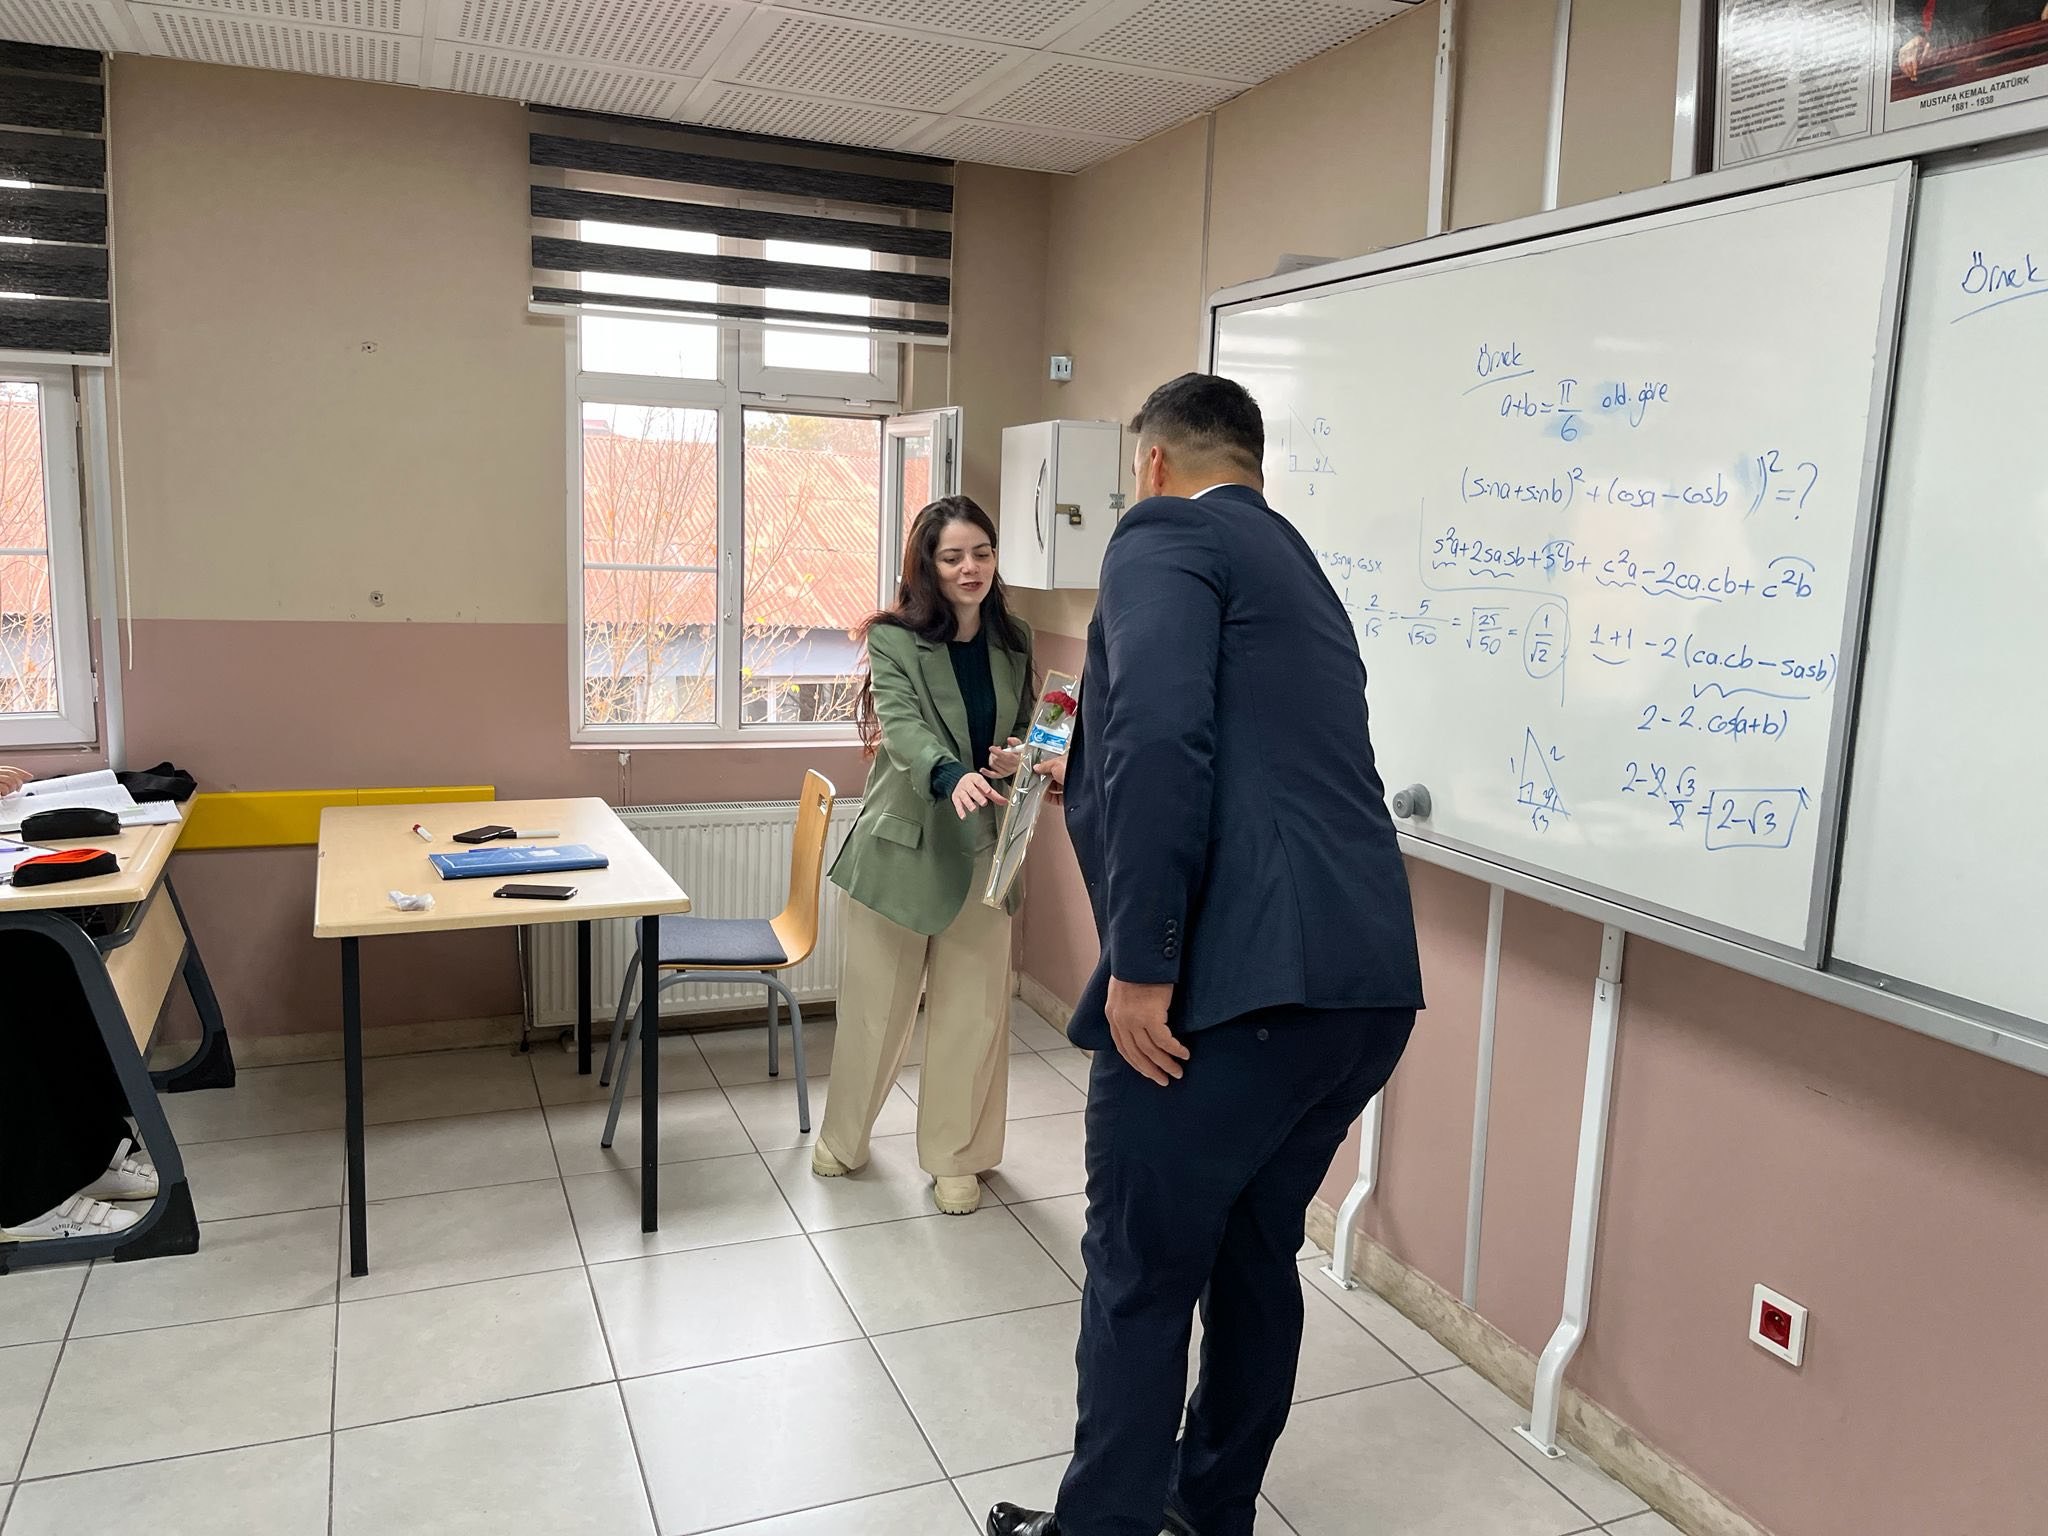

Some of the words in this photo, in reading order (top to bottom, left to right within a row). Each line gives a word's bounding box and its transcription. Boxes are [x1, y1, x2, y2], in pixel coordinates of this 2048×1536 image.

[1919, 93, 1957, 109] MUSTAFA
[1959, 86, 1988, 100] KEMAL
[1989, 75, 2030, 93] ATATÜRK
[1951, 101, 1968, 113] 1881
[1975, 95, 1995, 107] 1938
[1961, 250, 2048, 294] Örnek
[1477, 342, 1523, 377] Örnek
